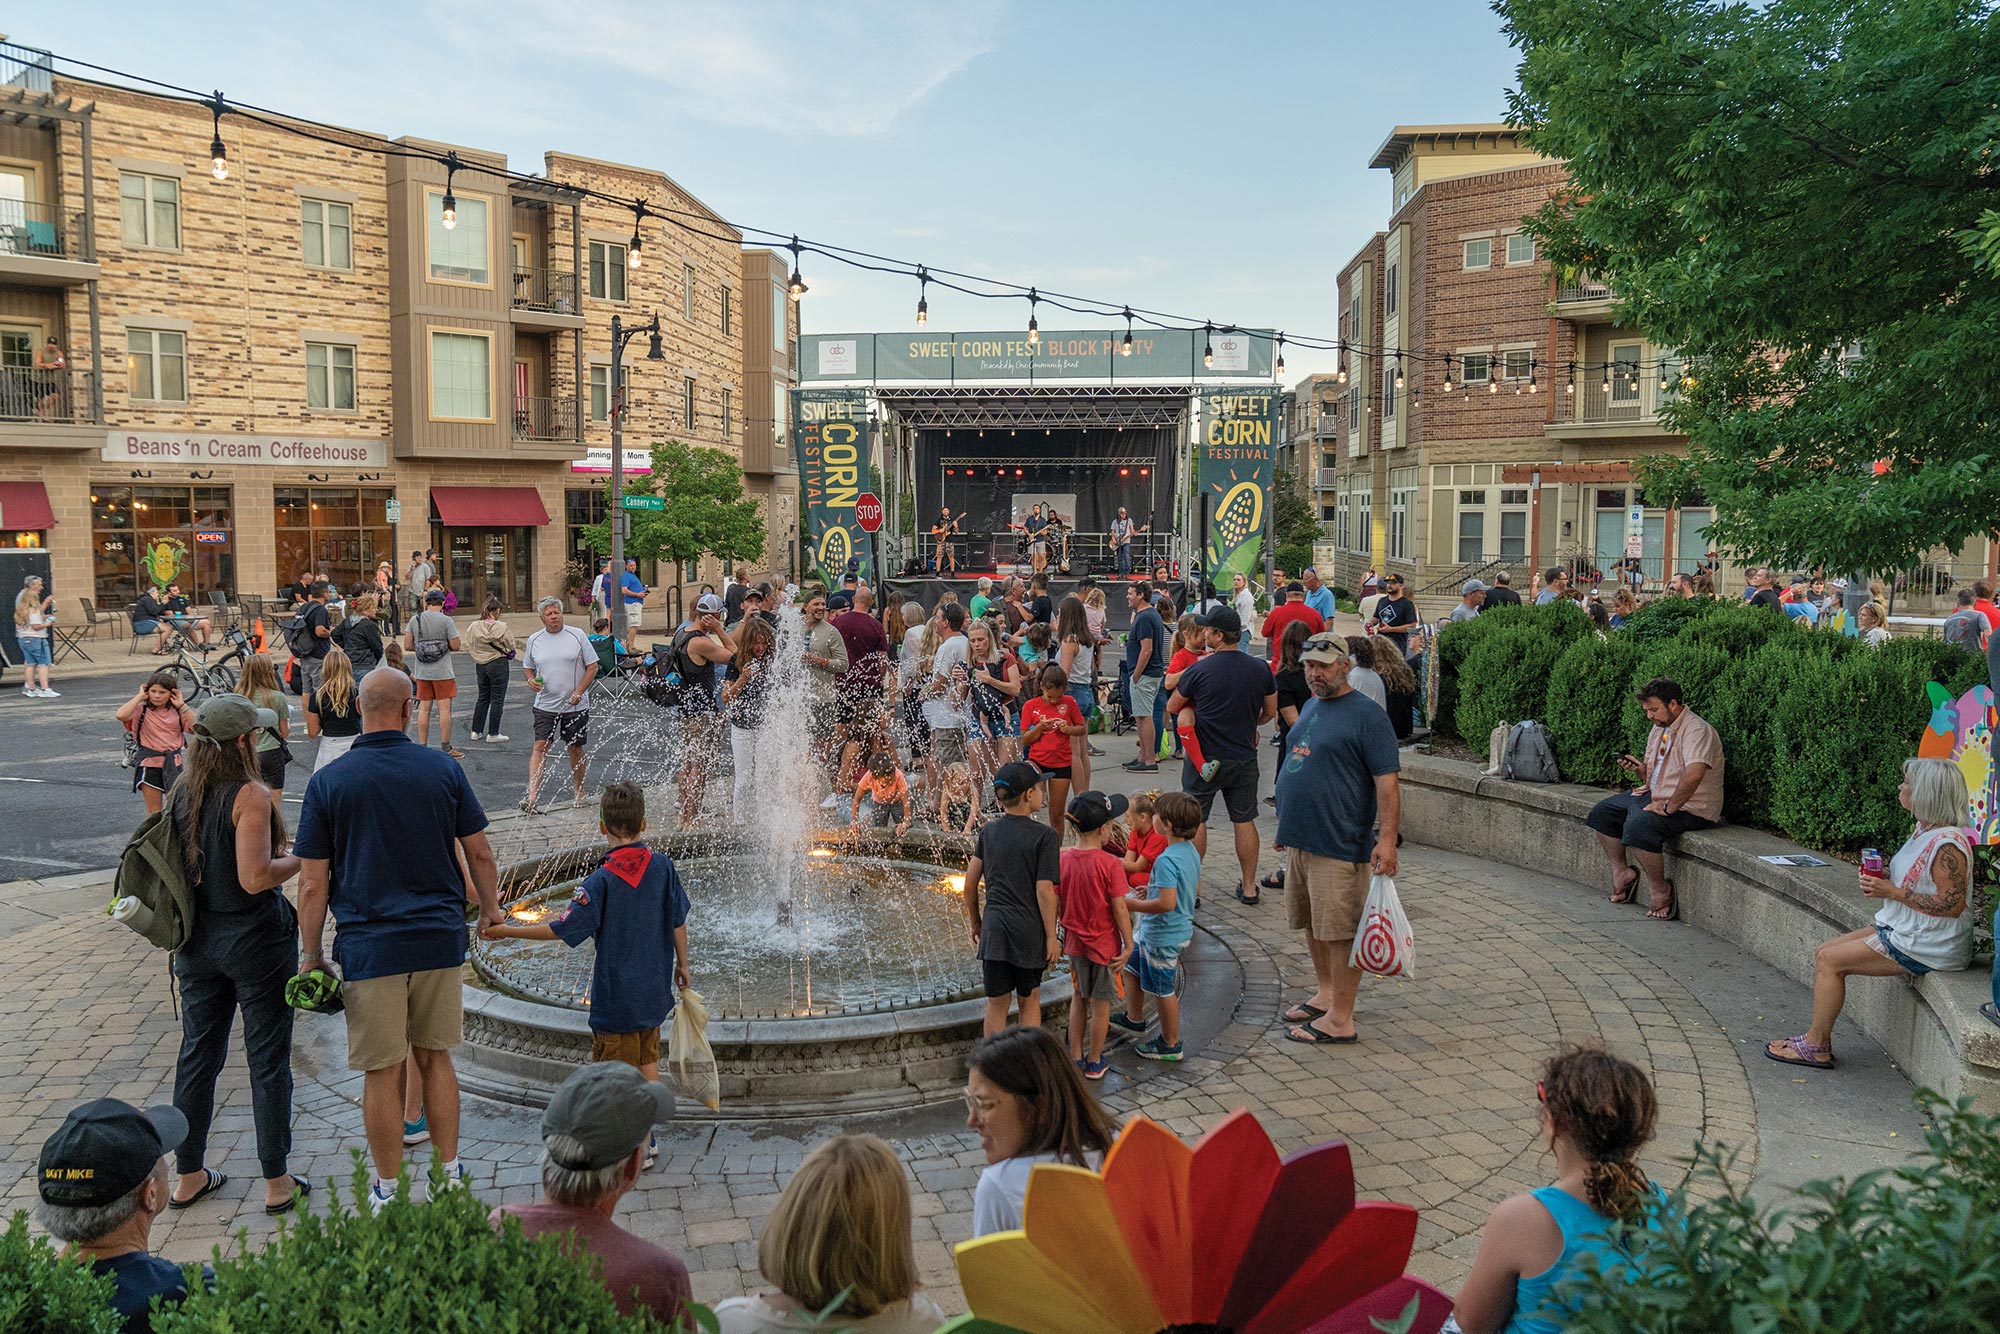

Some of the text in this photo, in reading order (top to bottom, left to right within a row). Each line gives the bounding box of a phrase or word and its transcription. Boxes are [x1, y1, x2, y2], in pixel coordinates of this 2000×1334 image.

[908, 338, 1154, 359] SWEET CORN FEST BLOCK PATY
[980, 358, 1080, 375] Presented by One Community Bank
[803, 402, 854, 420] SWEET
[1210, 396, 1272, 415] SWEET
[1208, 420, 1271, 446] CORN
[126, 436, 181, 456] Beans
[207, 438, 262, 459] Cream
[270, 440, 368, 461] Coffeehouse
[822, 424, 859, 507] CORN
[626, 497, 650, 508] Cannery
[857, 505, 881, 520] STOP
[196, 533, 223, 541] OPEN
[105, 542, 123, 550] 345
[66, 1168, 94, 1179] MIKE
